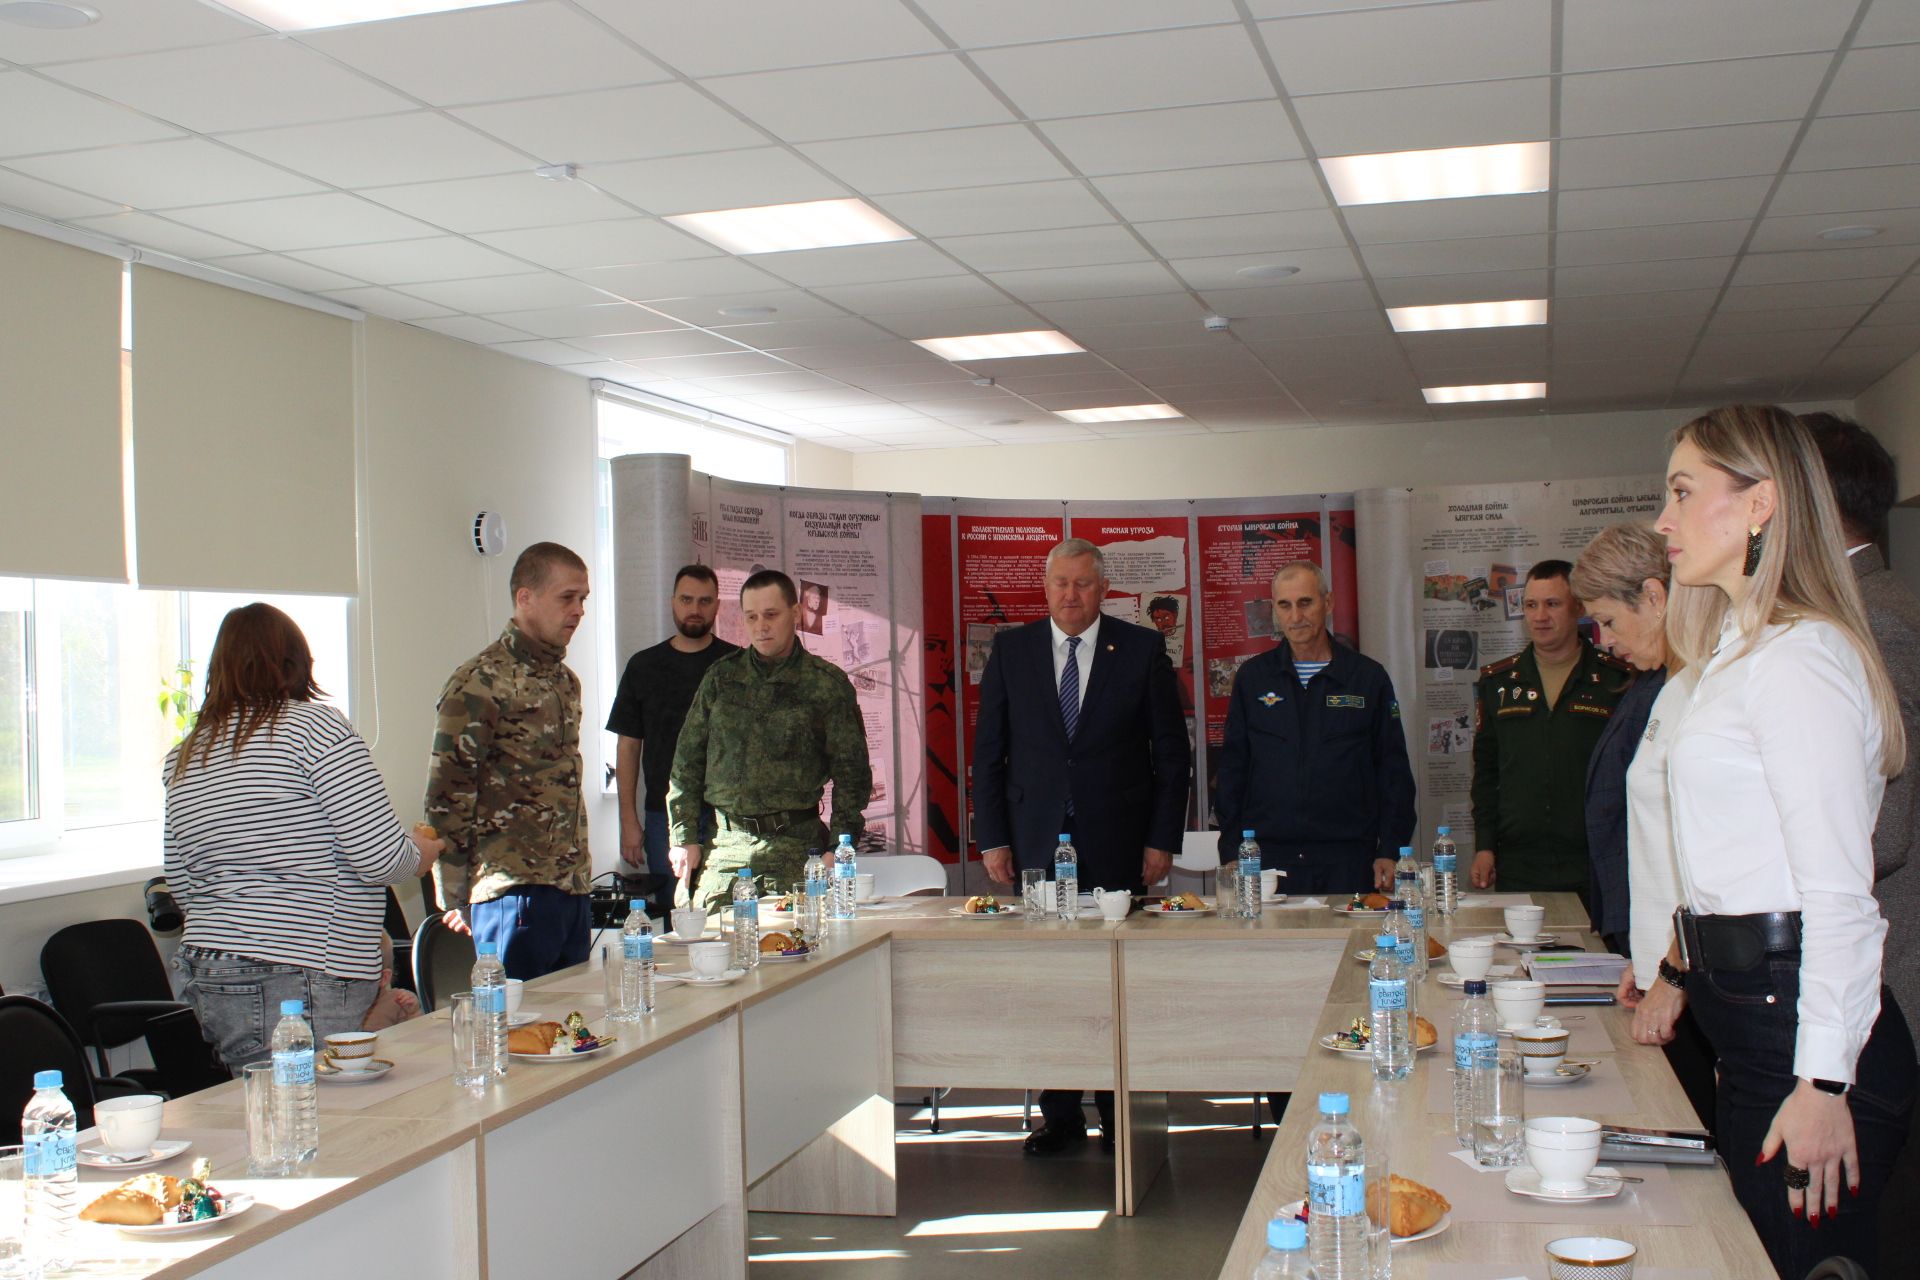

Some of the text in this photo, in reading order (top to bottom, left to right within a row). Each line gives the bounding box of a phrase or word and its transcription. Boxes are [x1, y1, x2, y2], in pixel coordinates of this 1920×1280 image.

[1448, 504, 1483, 512] ХОЛОДНАЯ
[1485, 513, 1503, 521] СИЛА
[971, 526, 1015, 534] КОЛЛЕКТИВНАЯ
[1218, 520, 1299, 532] ВТОРАЯ МИРОВАЯ ВОЙНА
[1130, 527, 1155, 535] УГРОЗА
[966, 533, 987, 541] РОССИИ
[992, 533, 1025, 541] ЯПОНСКИМ
[1025, 534, 1058, 542] АКЦЕНТОМ
